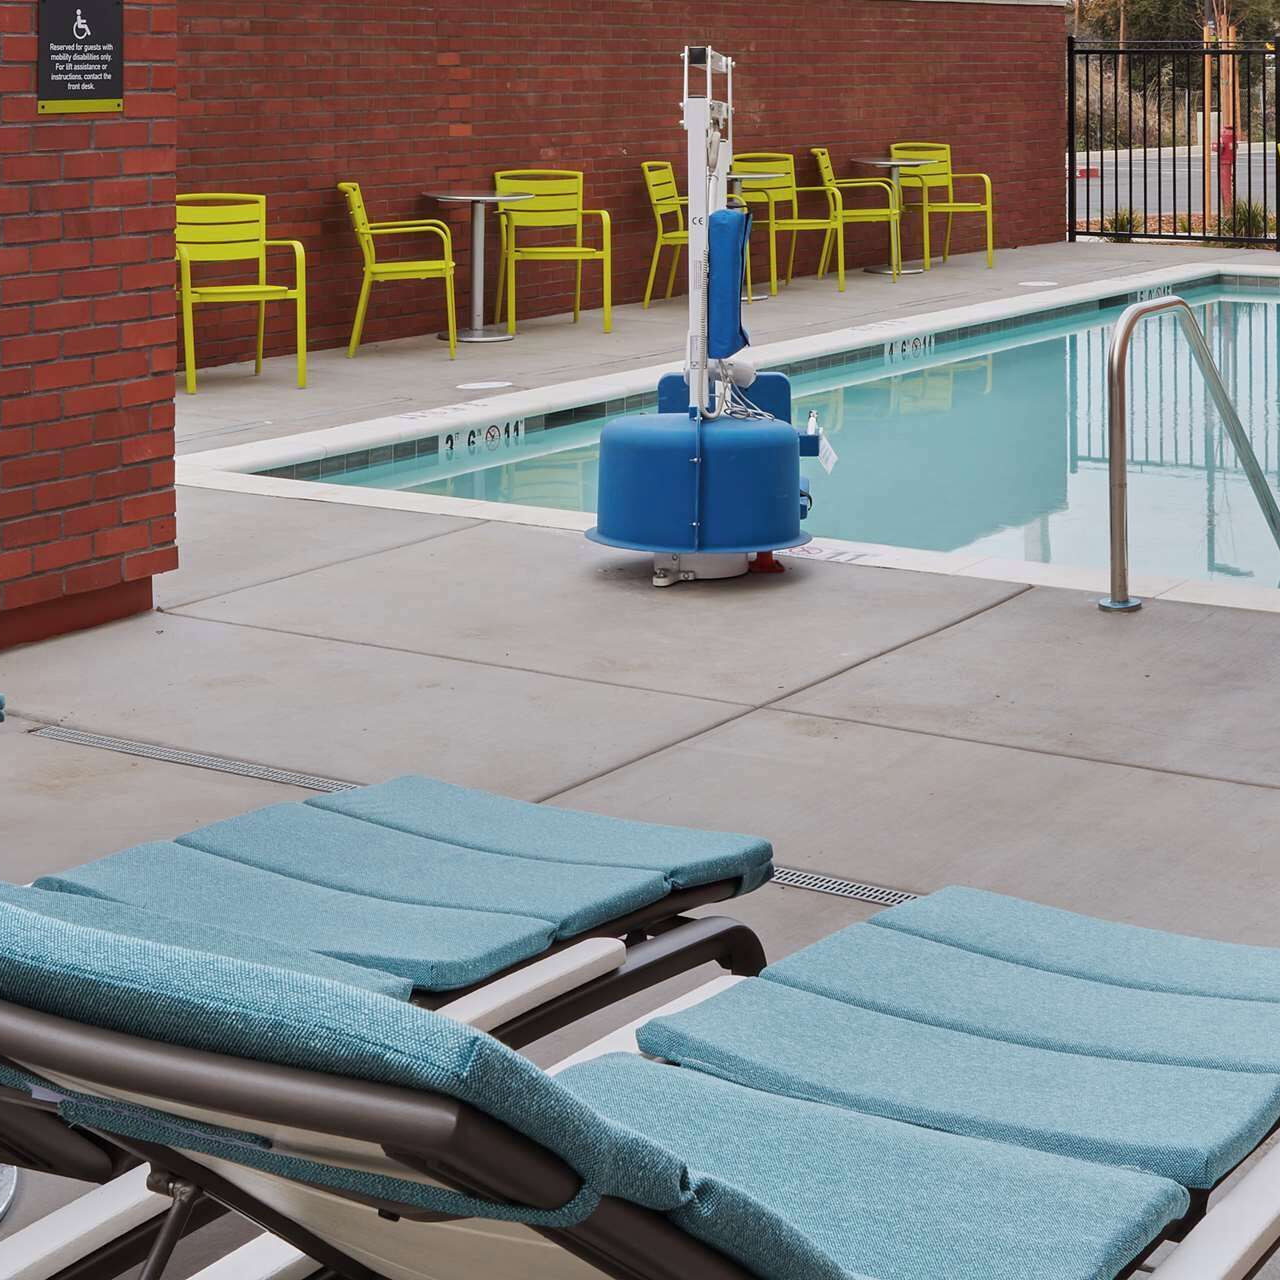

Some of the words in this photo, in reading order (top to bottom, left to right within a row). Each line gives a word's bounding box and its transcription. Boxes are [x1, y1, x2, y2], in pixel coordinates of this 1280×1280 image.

[50, 43, 75, 51] Reserved
[75, 43, 83, 51] for
[83, 44, 102, 53] guests
[102, 43, 113, 51] with
[50, 53, 71, 62] mobility
[72, 53, 100, 61] disabilities
[103, 72, 112, 80] the
[67, 82, 80, 90] front
